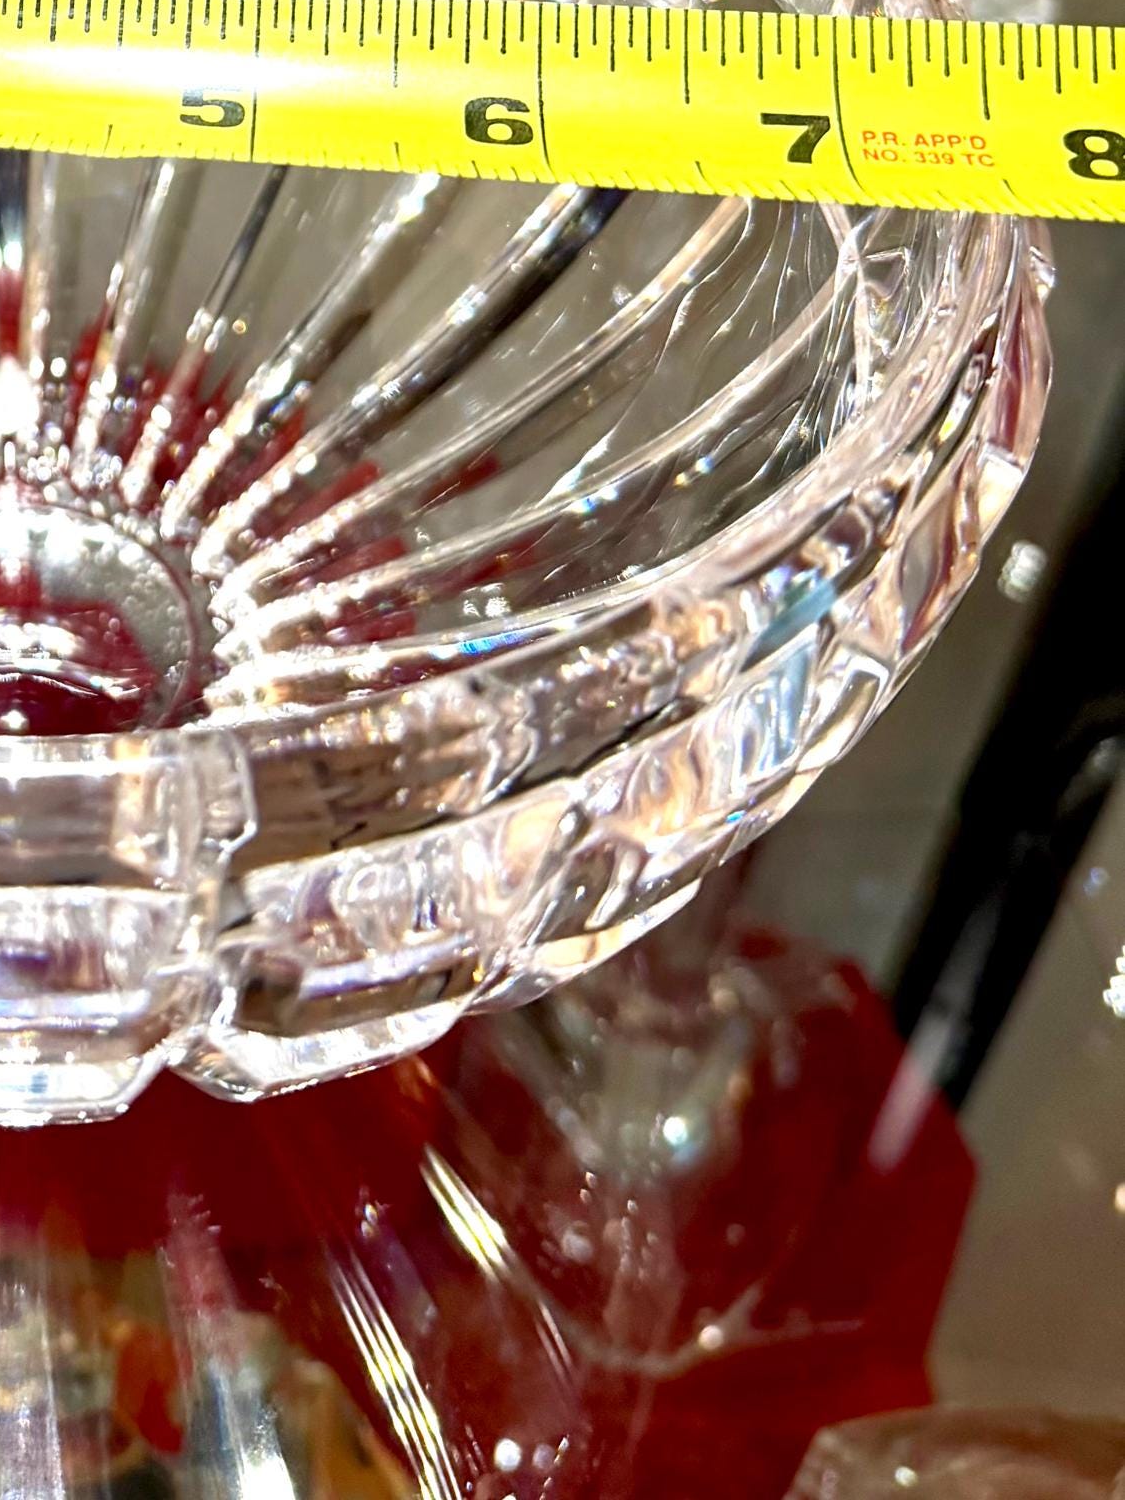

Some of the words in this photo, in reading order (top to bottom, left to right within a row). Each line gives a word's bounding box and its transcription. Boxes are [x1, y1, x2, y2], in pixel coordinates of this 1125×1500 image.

[180, 86, 245, 127] 5
[464, 97, 534, 145] 6
[760, 112, 831, 164] 7
[862, 130, 906, 146] P.R.
[913, 133, 987, 150] APP'D
[862, 149, 907, 163] NO.
[914, 151, 955, 166] 339
[959, 153, 995, 168] TC
[1063, 129, 1125, 180] 8
